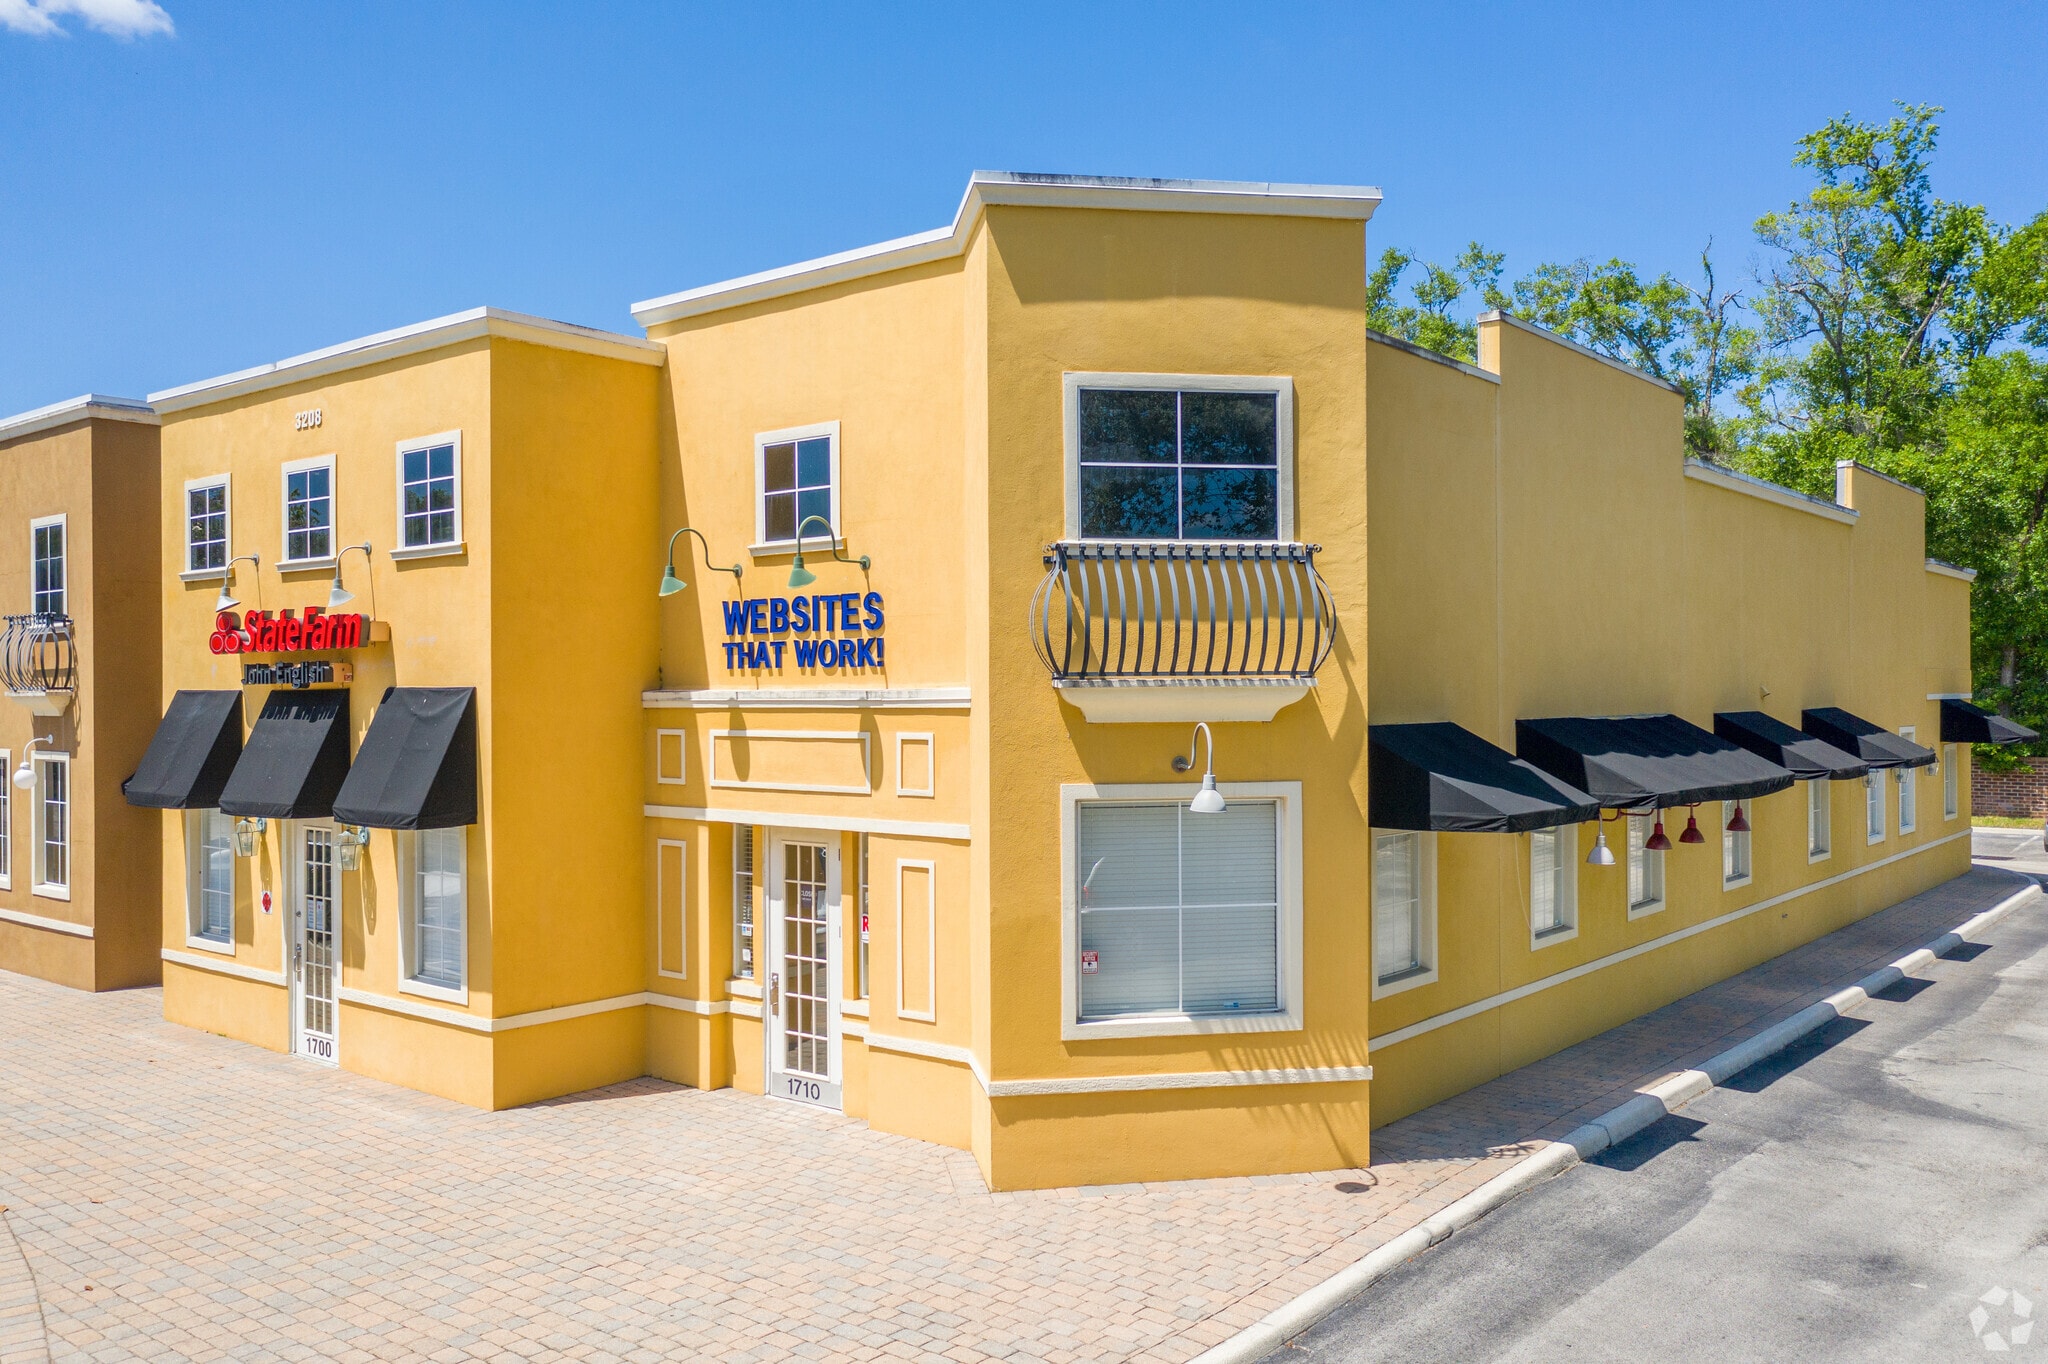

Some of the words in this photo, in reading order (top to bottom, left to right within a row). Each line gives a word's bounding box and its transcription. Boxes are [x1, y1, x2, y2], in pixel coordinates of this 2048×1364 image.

[295, 408, 323, 430] 3208
[722, 591, 885, 636] WEBSITES
[722, 641, 786, 669] THAT
[794, 637, 885, 669] WORK!
[241, 663, 272, 685] John
[275, 661, 325, 689] English
[306, 1037, 332, 1059] 1700
[787, 1077, 821, 1101] 1710
